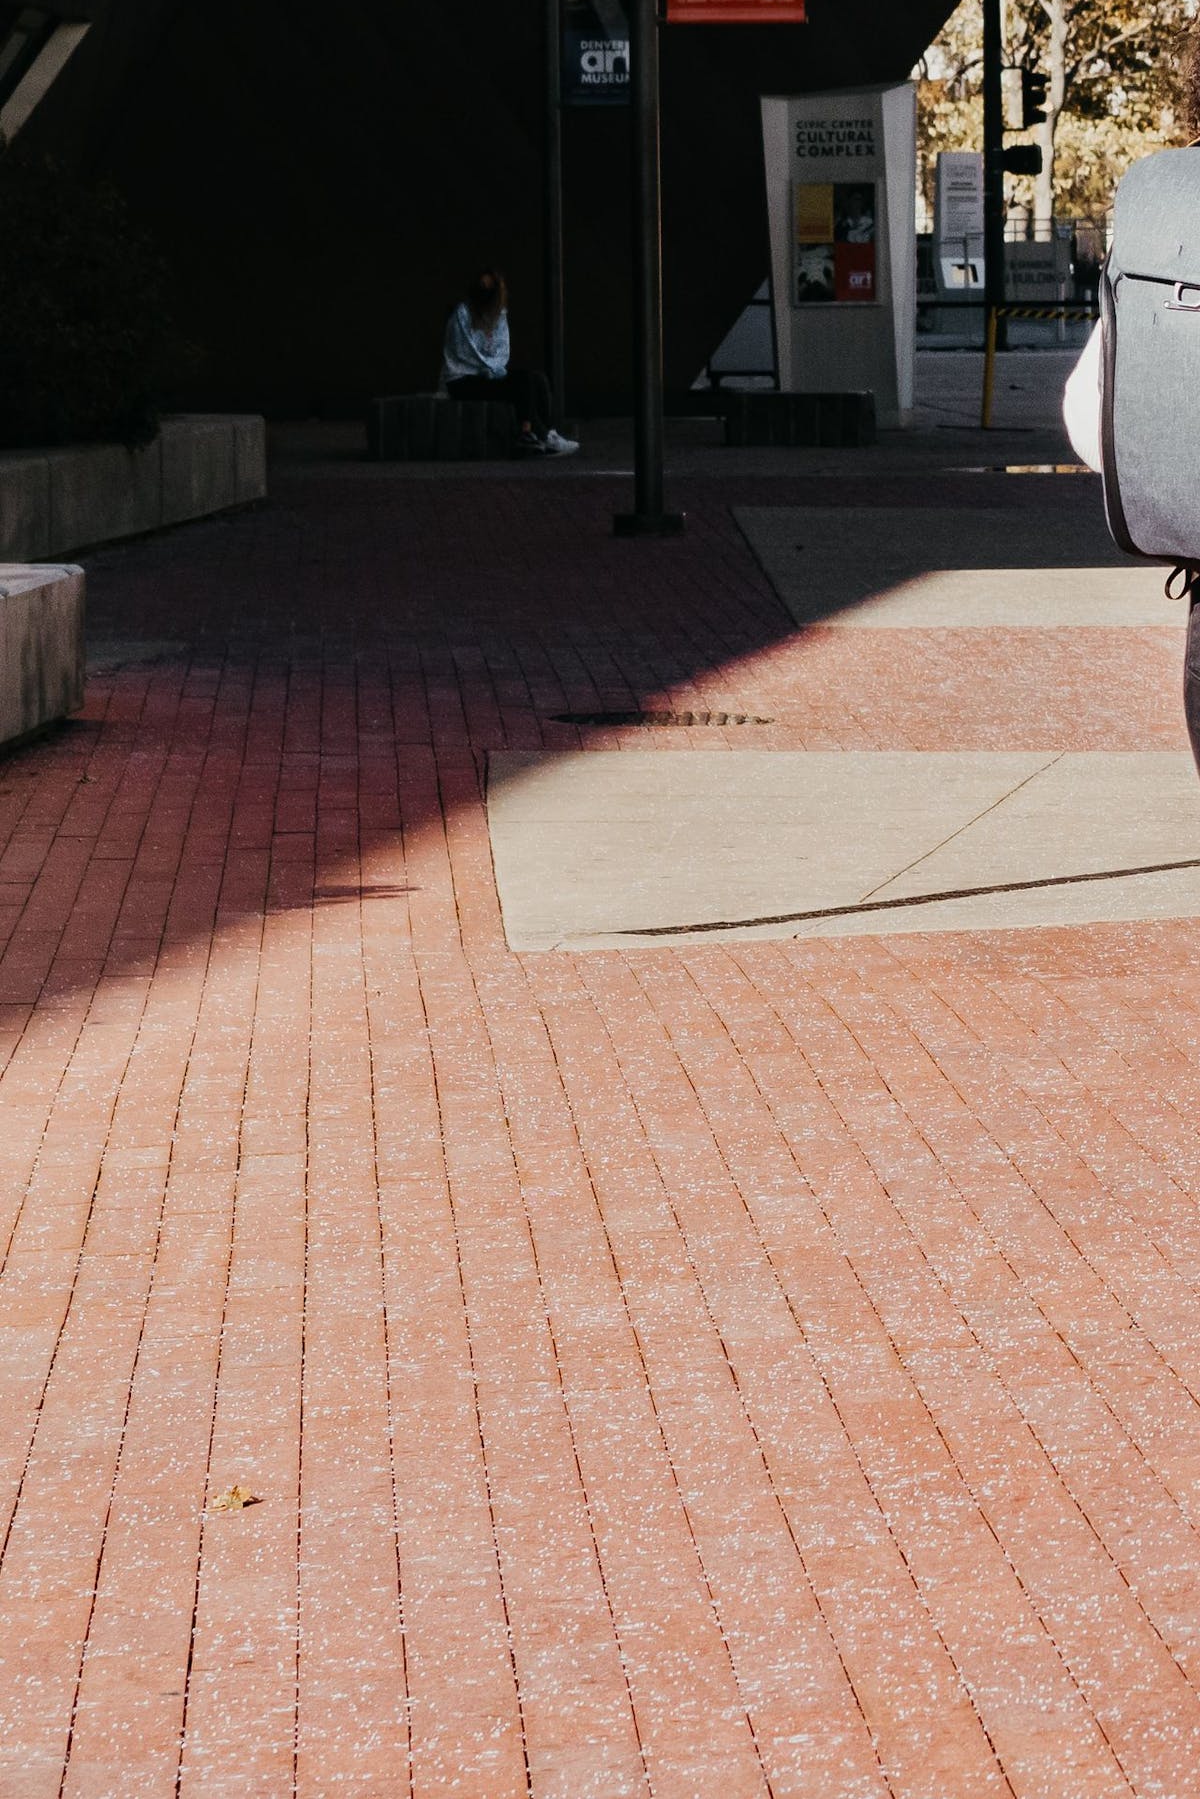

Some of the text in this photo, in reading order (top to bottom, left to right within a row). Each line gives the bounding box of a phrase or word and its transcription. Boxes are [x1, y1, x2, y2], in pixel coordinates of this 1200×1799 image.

[796, 119, 873, 129] CIVIC CENTER
[796, 130, 875, 144] CULTURAL
[796, 144, 875, 157] COMPLEX
